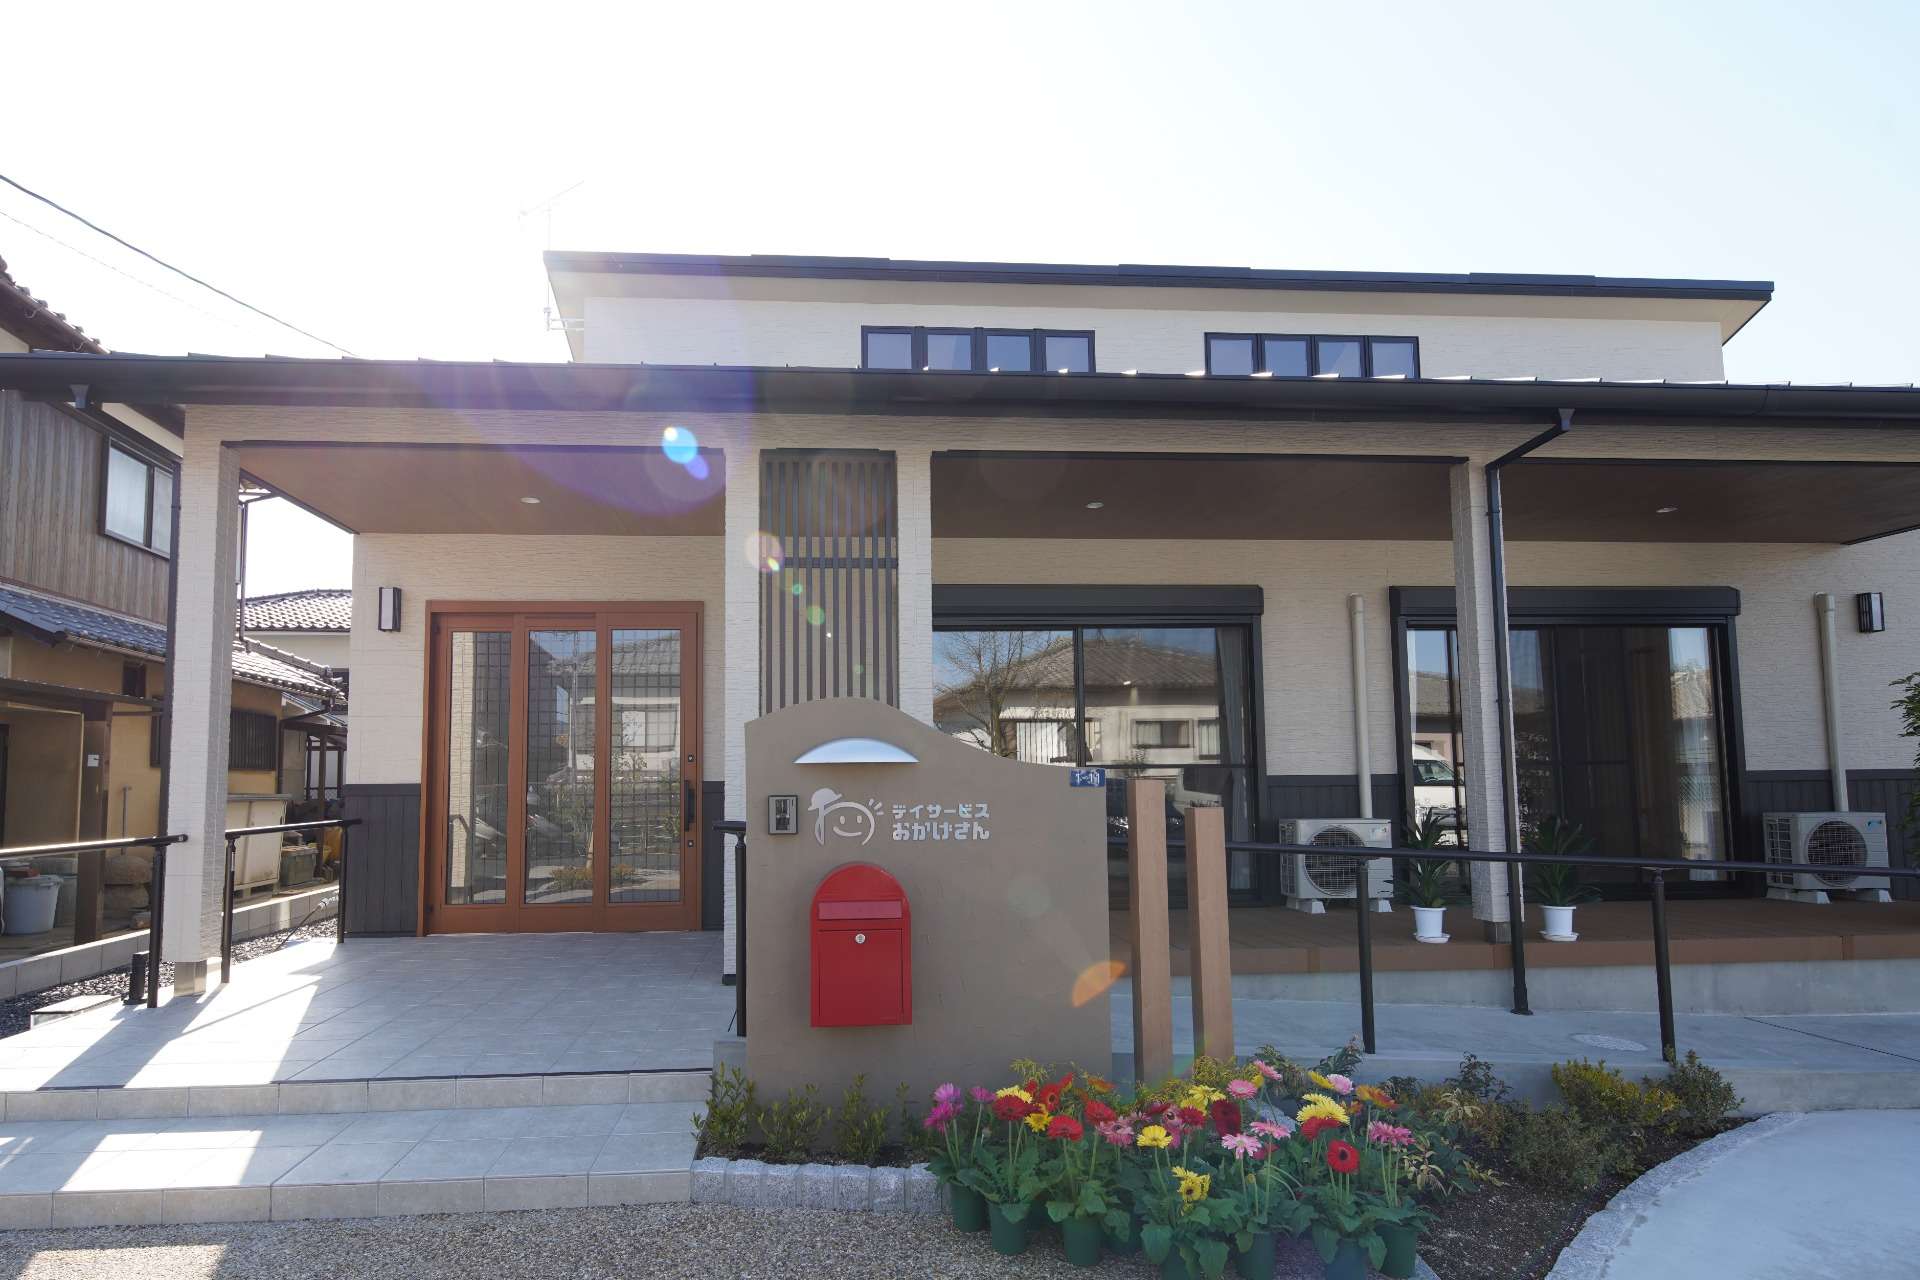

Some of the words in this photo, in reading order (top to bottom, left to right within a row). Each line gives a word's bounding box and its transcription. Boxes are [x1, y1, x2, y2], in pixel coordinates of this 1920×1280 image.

[892, 803, 990, 819] デイサービス
